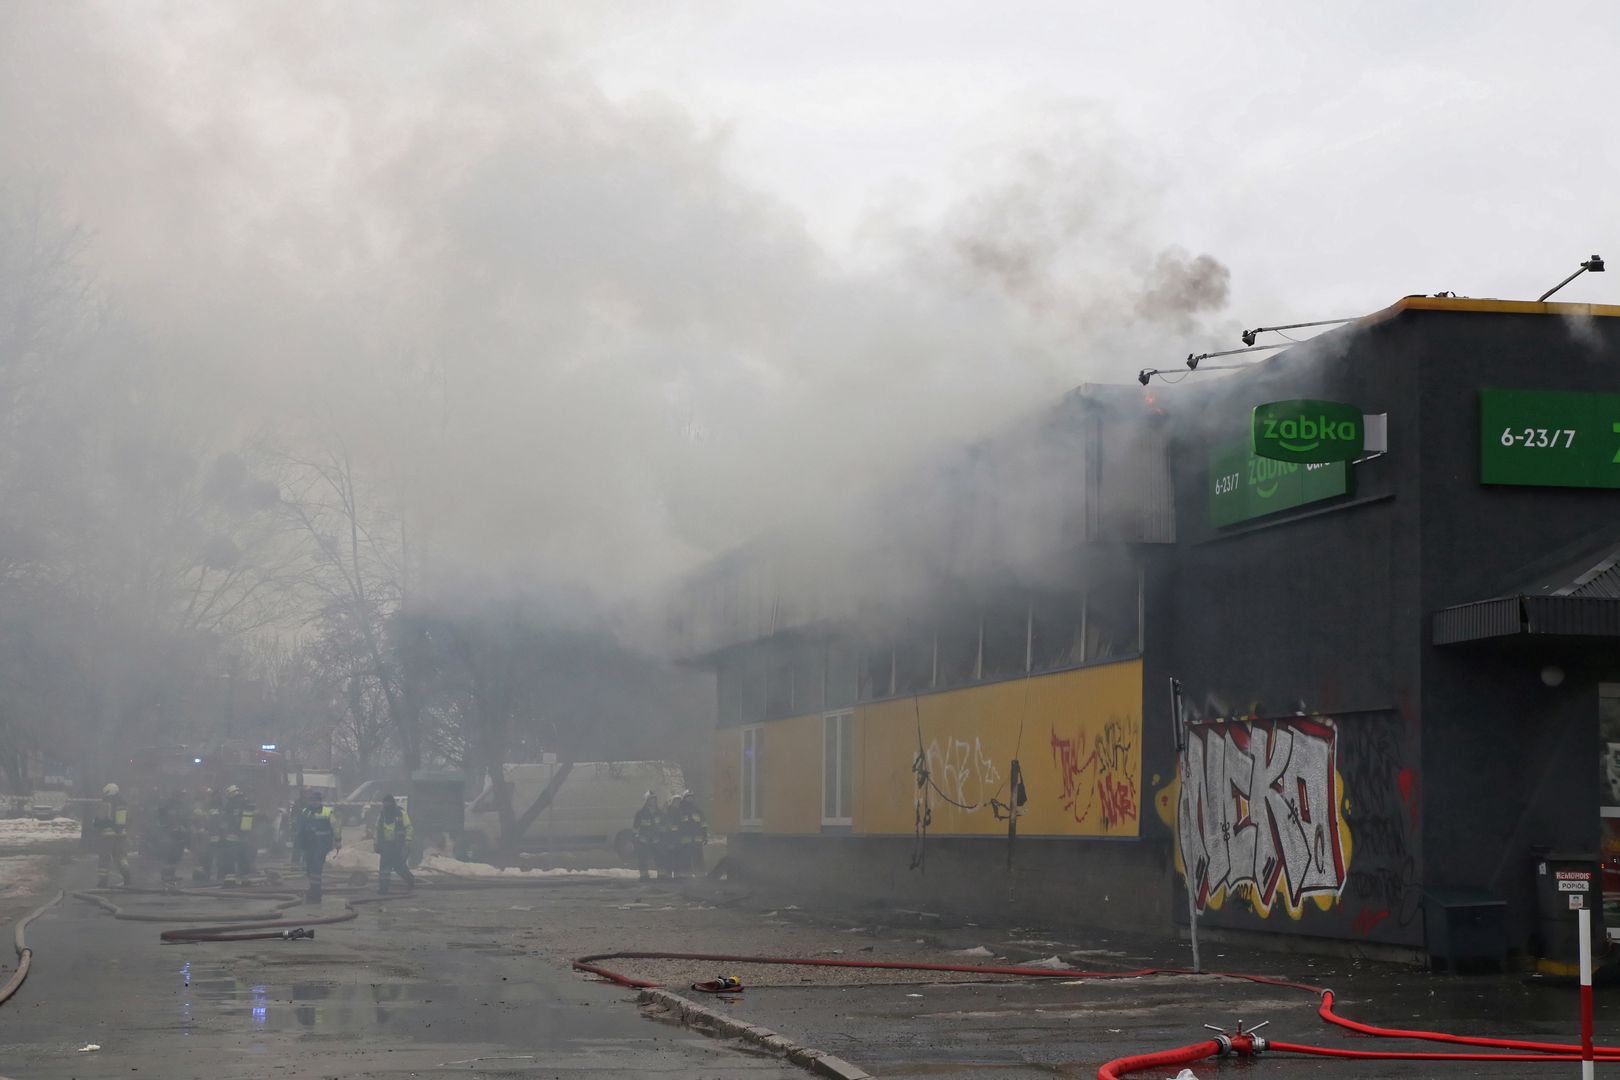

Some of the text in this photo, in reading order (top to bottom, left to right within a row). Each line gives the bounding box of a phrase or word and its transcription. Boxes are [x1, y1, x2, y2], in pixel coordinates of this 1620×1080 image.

[1264, 414, 1355, 440] żabka
[1501, 427, 1576, 448] 6-23/7
[1215, 472, 1239, 495] 6-23/7
